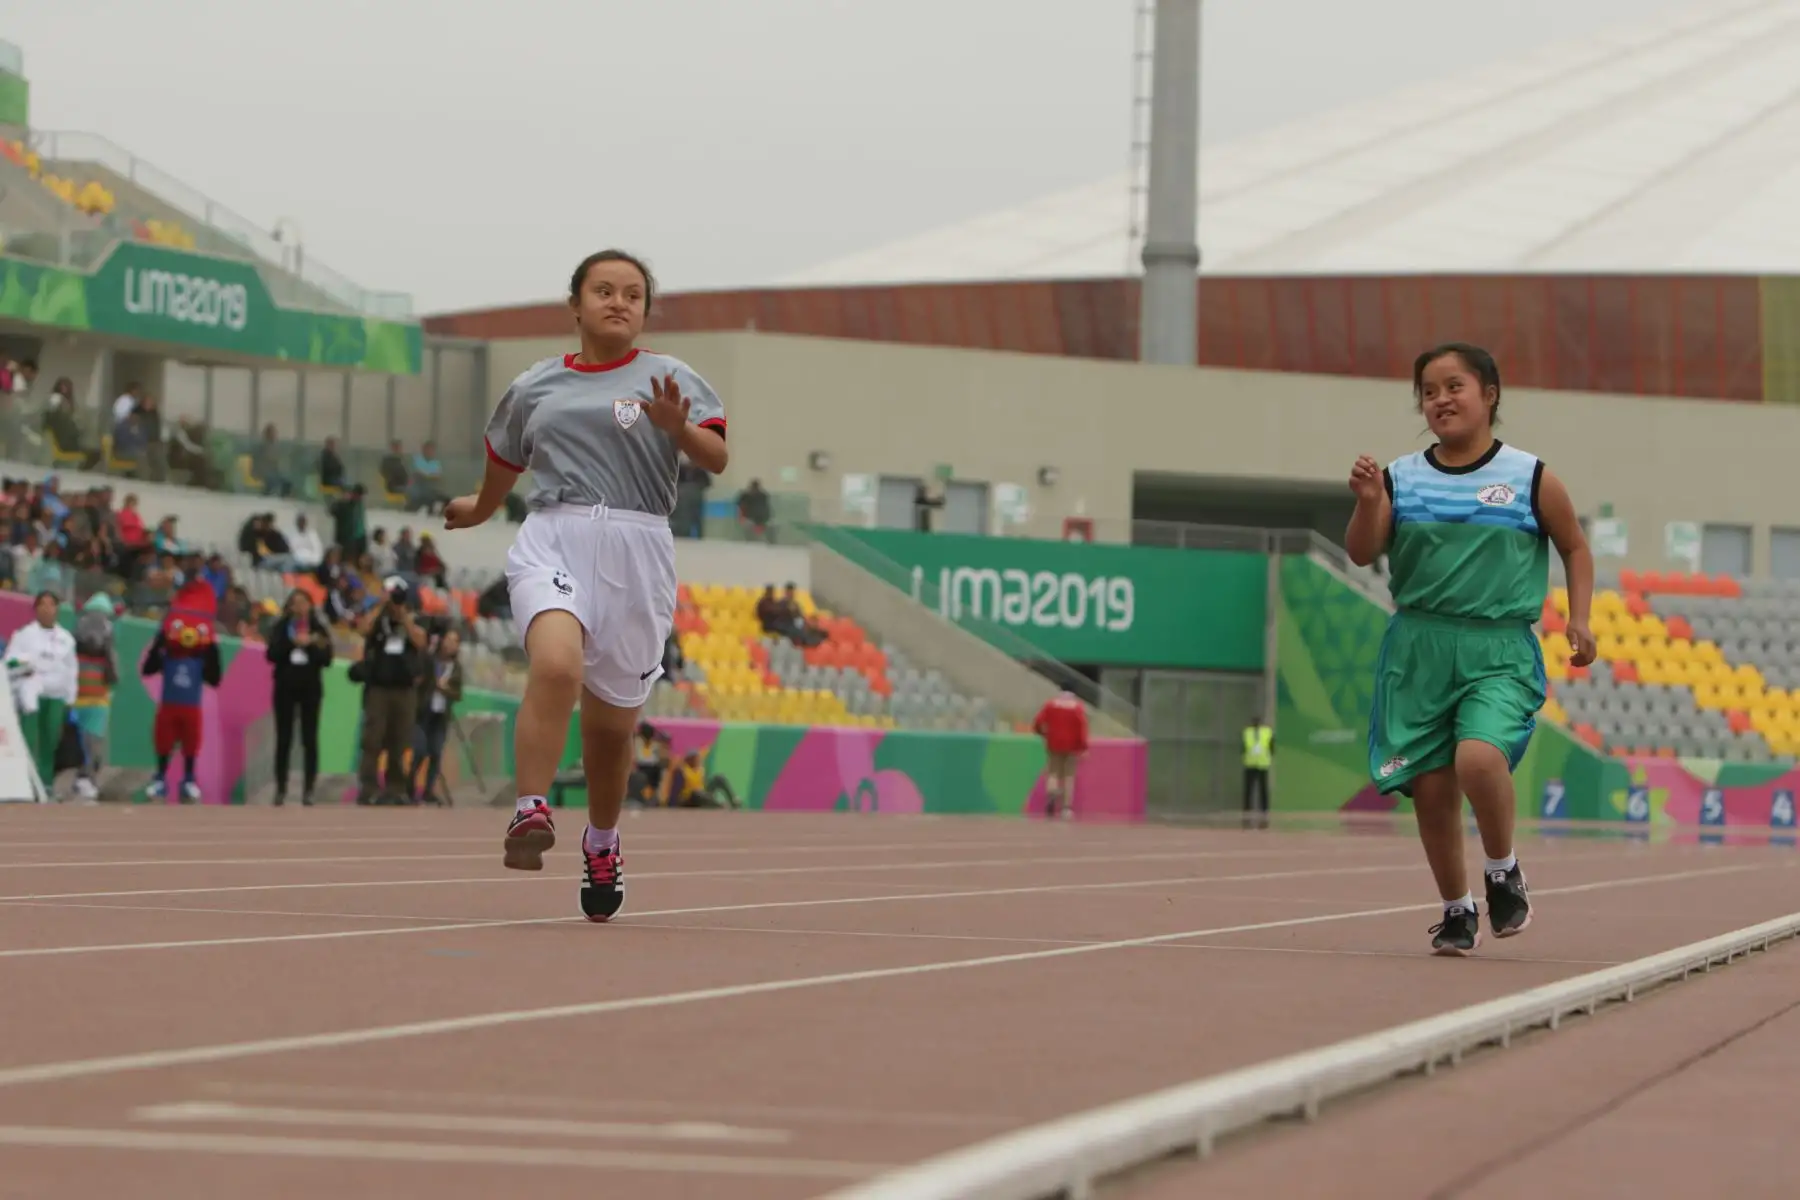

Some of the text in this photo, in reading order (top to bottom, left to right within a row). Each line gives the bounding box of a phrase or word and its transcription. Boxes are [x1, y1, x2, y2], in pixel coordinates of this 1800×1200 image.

[1545, 784, 1565, 816] 7
[1628, 790, 1648, 820] 6
[1704, 788, 1722, 821] 5
[1772, 793, 1793, 825] 4
